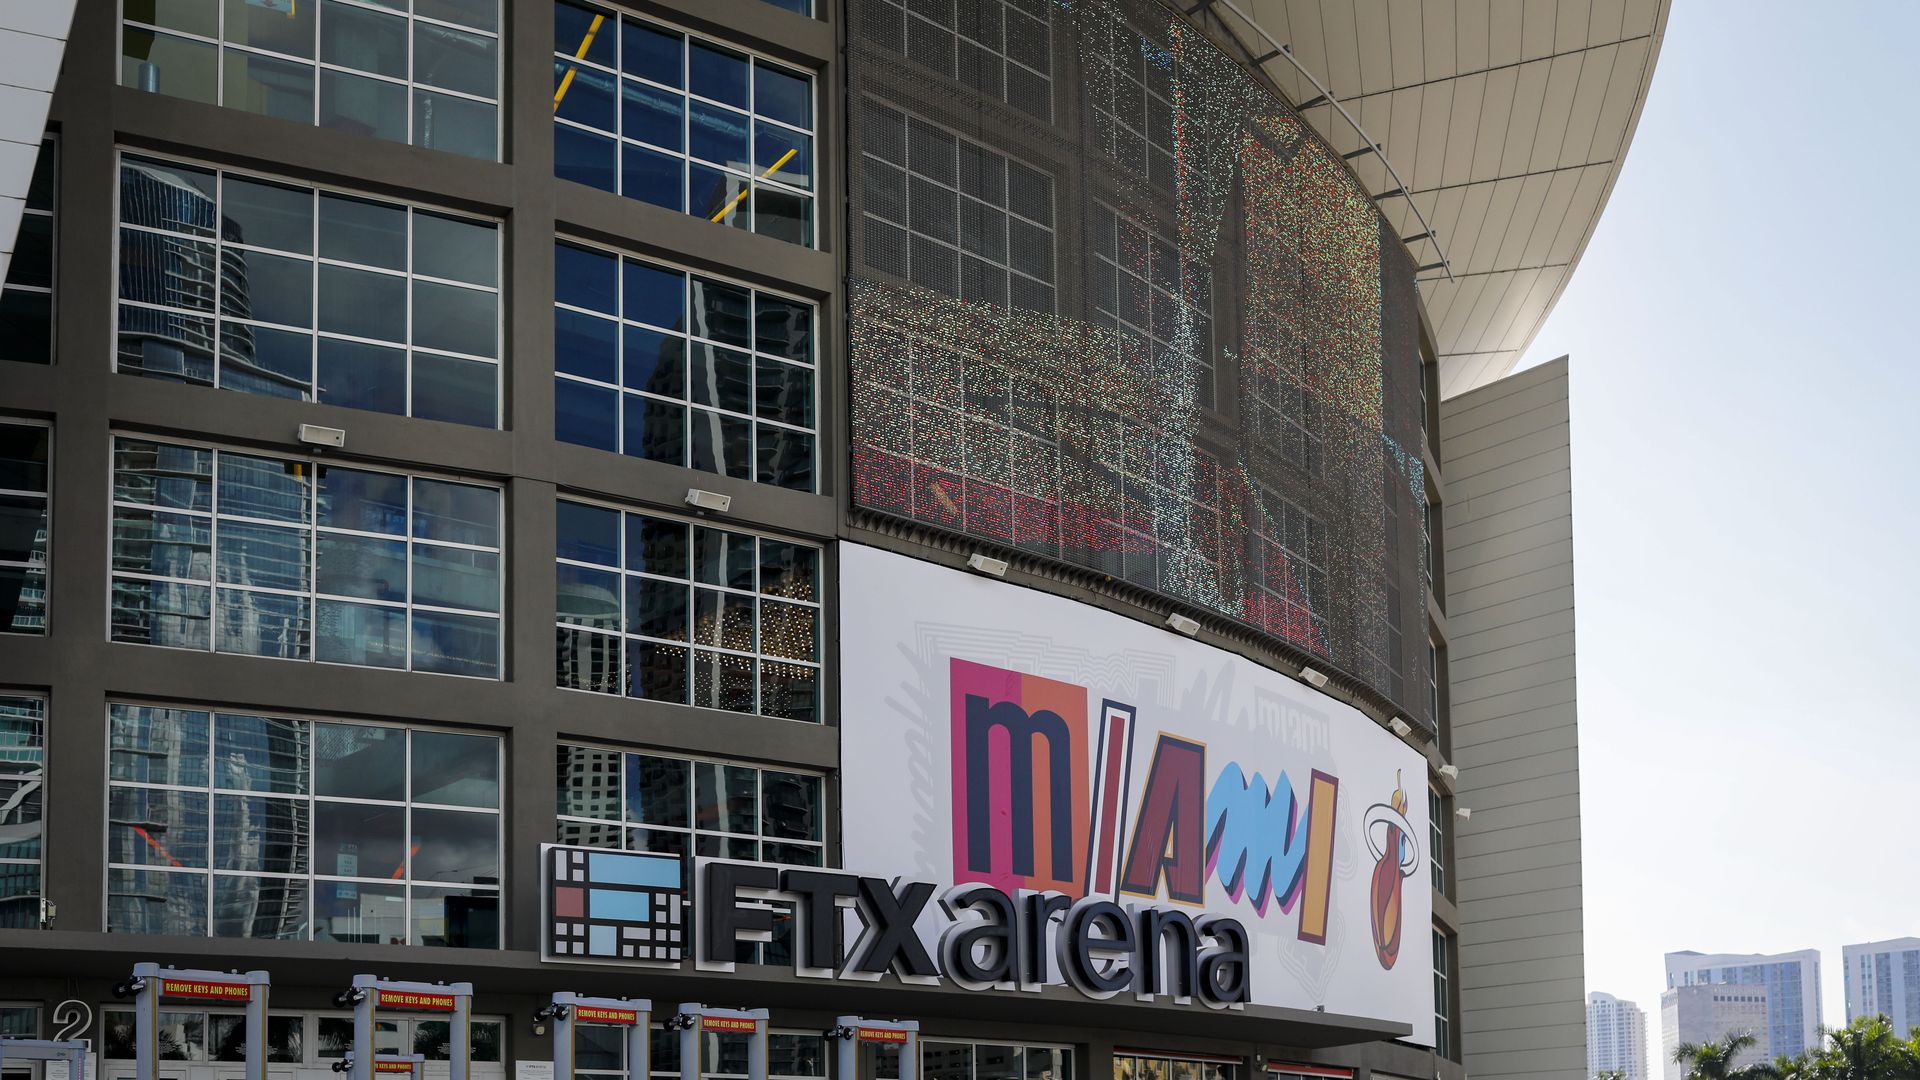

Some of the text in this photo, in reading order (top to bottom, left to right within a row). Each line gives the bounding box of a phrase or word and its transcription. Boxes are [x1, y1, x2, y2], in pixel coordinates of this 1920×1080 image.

[698, 859, 1251, 1009] FTX arena
[165, 982, 249, 997] REMOVE KEYS AND PHONES
[381, 993, 454, 1007] REMOVE KEYS AND PHONES
[578, 1009, 635, 1022] REMOVE KEYS AND PHONES
[53, 999, 92, 1053] 2
[704, 1019, 754, 1030] REMOVE KEYS AND PHONES
[860, 1030, 875, 1038] REMOVE
